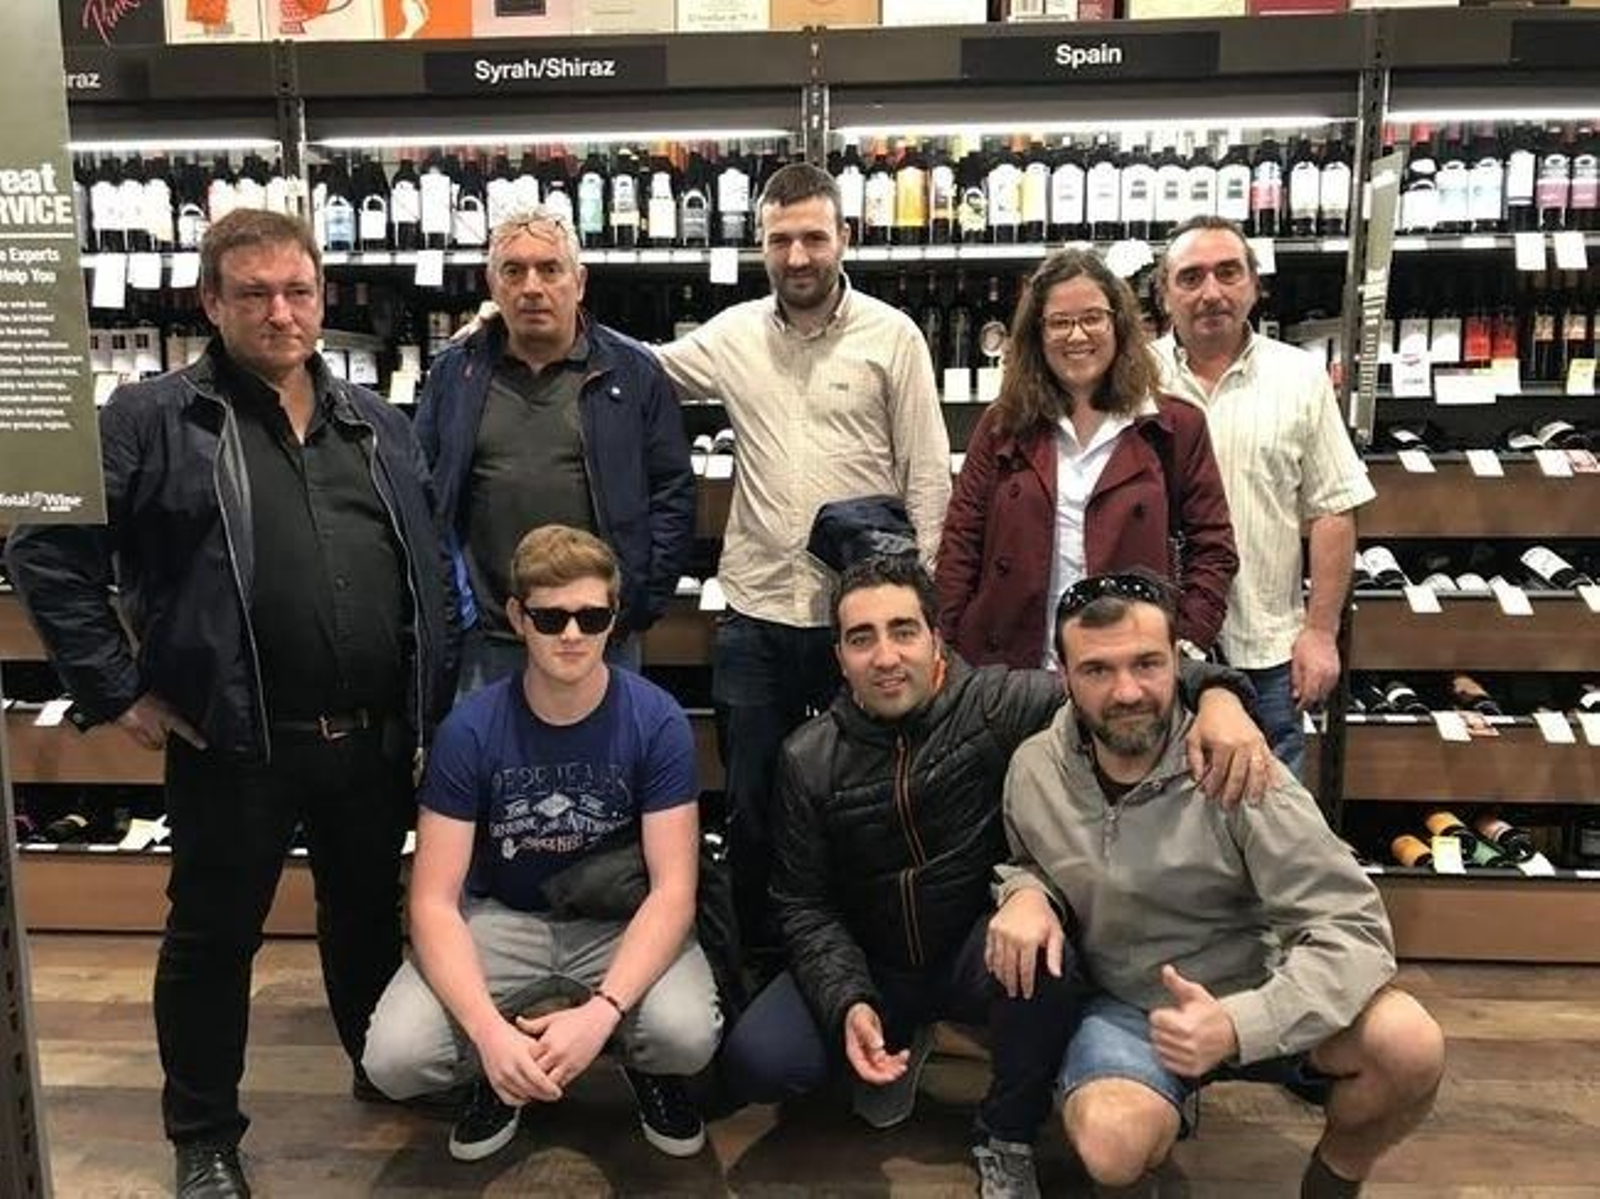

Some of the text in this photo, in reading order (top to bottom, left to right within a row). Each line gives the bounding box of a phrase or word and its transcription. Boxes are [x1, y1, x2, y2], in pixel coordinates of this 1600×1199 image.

[1055, 43, 1123, 69] Spain
[474, 58, 616, 84] Syrah/Shiraz
[0, 163, 57, 195] eat
[9, 247, 60, 265] Experts
[31, 268, 57, 283] You
